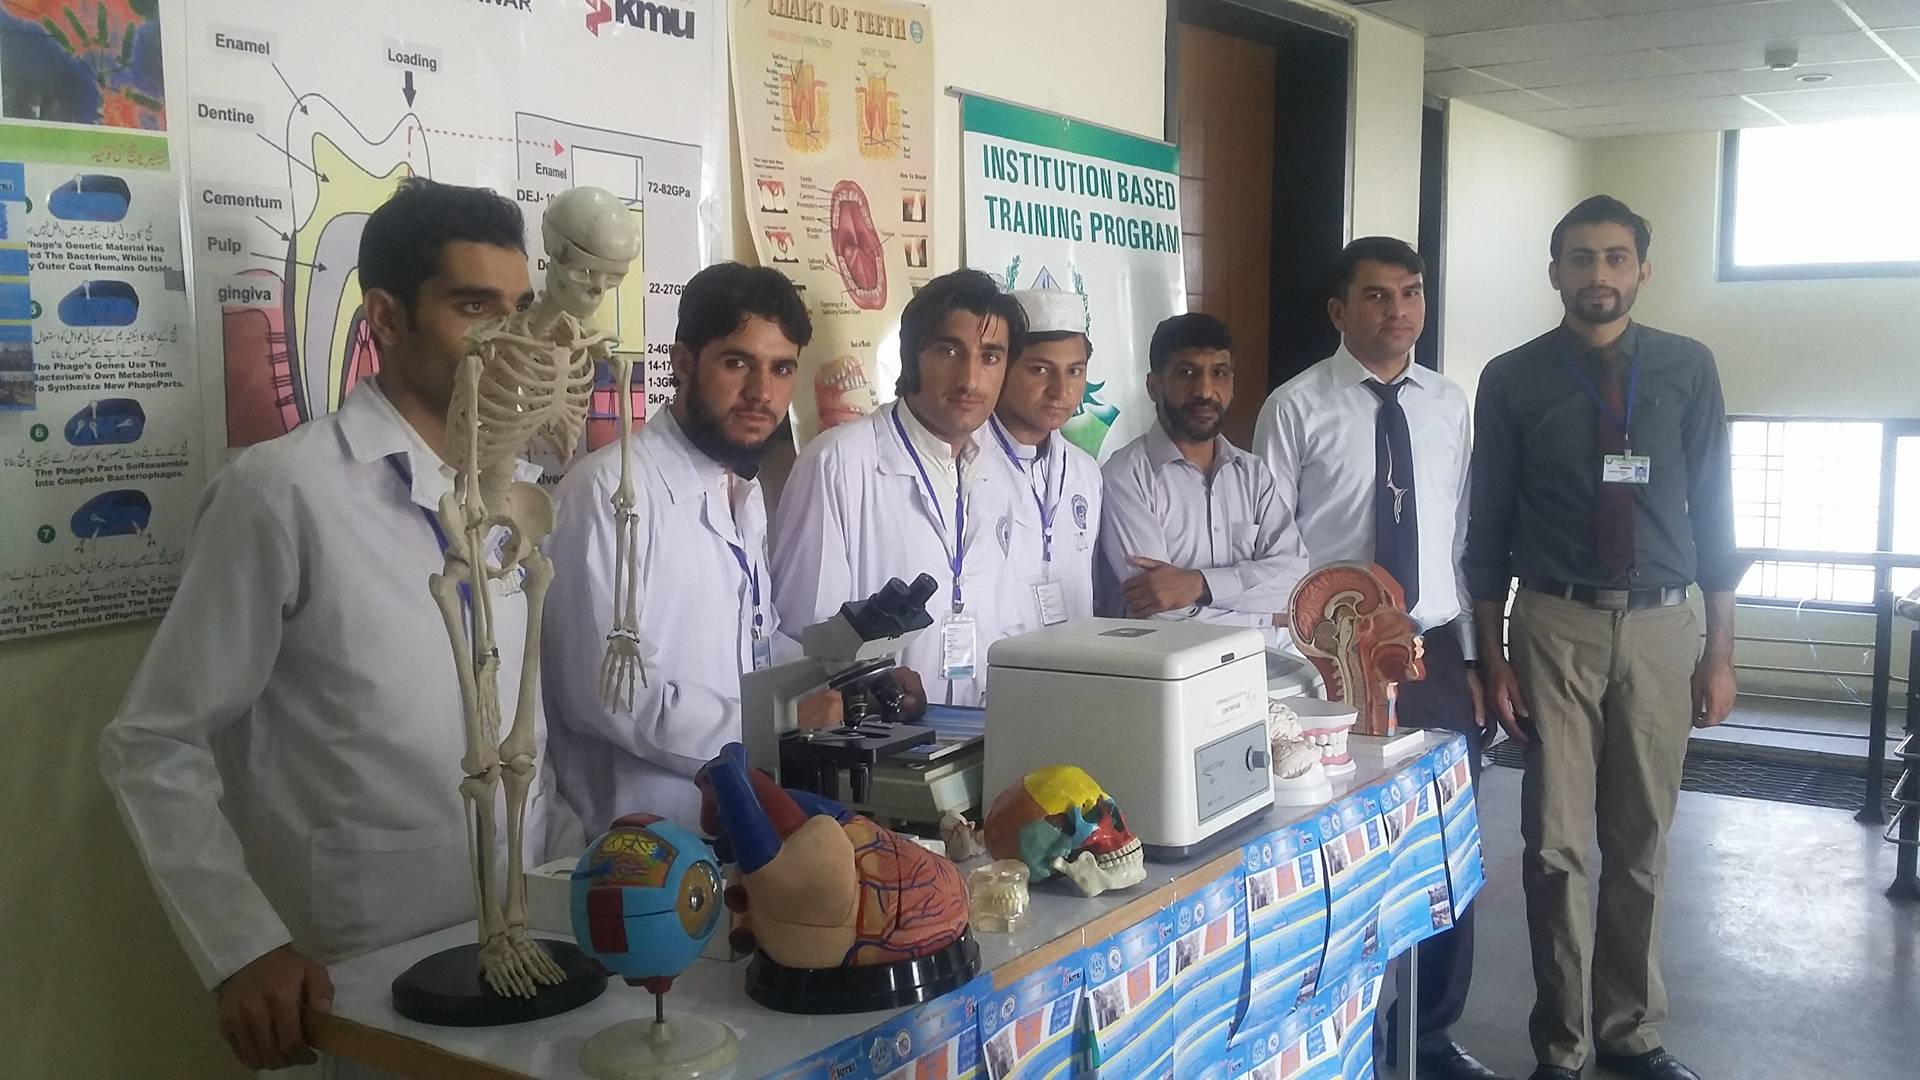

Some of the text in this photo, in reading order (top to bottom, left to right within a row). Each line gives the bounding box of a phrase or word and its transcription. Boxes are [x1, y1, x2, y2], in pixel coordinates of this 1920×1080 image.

[615, 0, 695, 39] kmu
[768, 0, 907, 40] CHART OF TEETH
[215, 33, 270, 55] Enamel
[388, 48, 437, 72] Loading
[198, 103, 255, 124] Dentine
[535, 162, 567, 180] Enamel
[983, 144, 1176, 211] INSTITUTION BASED
[648, 181, 691, 198] 72-82GPa
[203, 189, 282, 210] Cementum
[984, 195, 1181, 254] TRAINING PROGRAM
[27, 240, 165, 252] hage's Genetic Material Has
[207, 236, 242, 255] Pulp
[29, 252, 41, 260] ed
[44, 252, 64, 260] The
[38, 263, 65, 271] Outer
[94, 264, 135, 272] Remains
[218, 284, 271, 303] gingiva
[54, 362, 92, 372] Phage's
[95, 361, 125, 370] Genes
[128, 361, 147, 369] Use
[149, 360, 167, 368] The
[35, 372, 91, 382] acterium's
[119, 371, 173, 380] Metabolism
[48, 383, 101, 394] Synthesize
[104, 382, 125, 390] New
[34, 468, 53, 477] The
[56, 466, 95, 477] Phage's
[98, 464, 123, 473] Parts
[35, 479, 55, 488] Into
[58, 476, 104, 487] Complete
[32, 600, 63, 611] Phage
[93, 592, 128, 602] Directs
[131, 589, 148, 597] The
[151, 585, 177, 596] Synth
[17, 613, 54, 624] Enzyme
[57, 608, 79, 617] That
[82, 602, 125, 614] Ruptures
[128, 600, 146, 608] The
[149, 596, 174, 606] Bacte
[29, 623, 48, 632] The
[51, 615, 102, 629] Completed
[105, 610, 148, 622] Offspring
[837, 1058, 856, 1078] kmu
